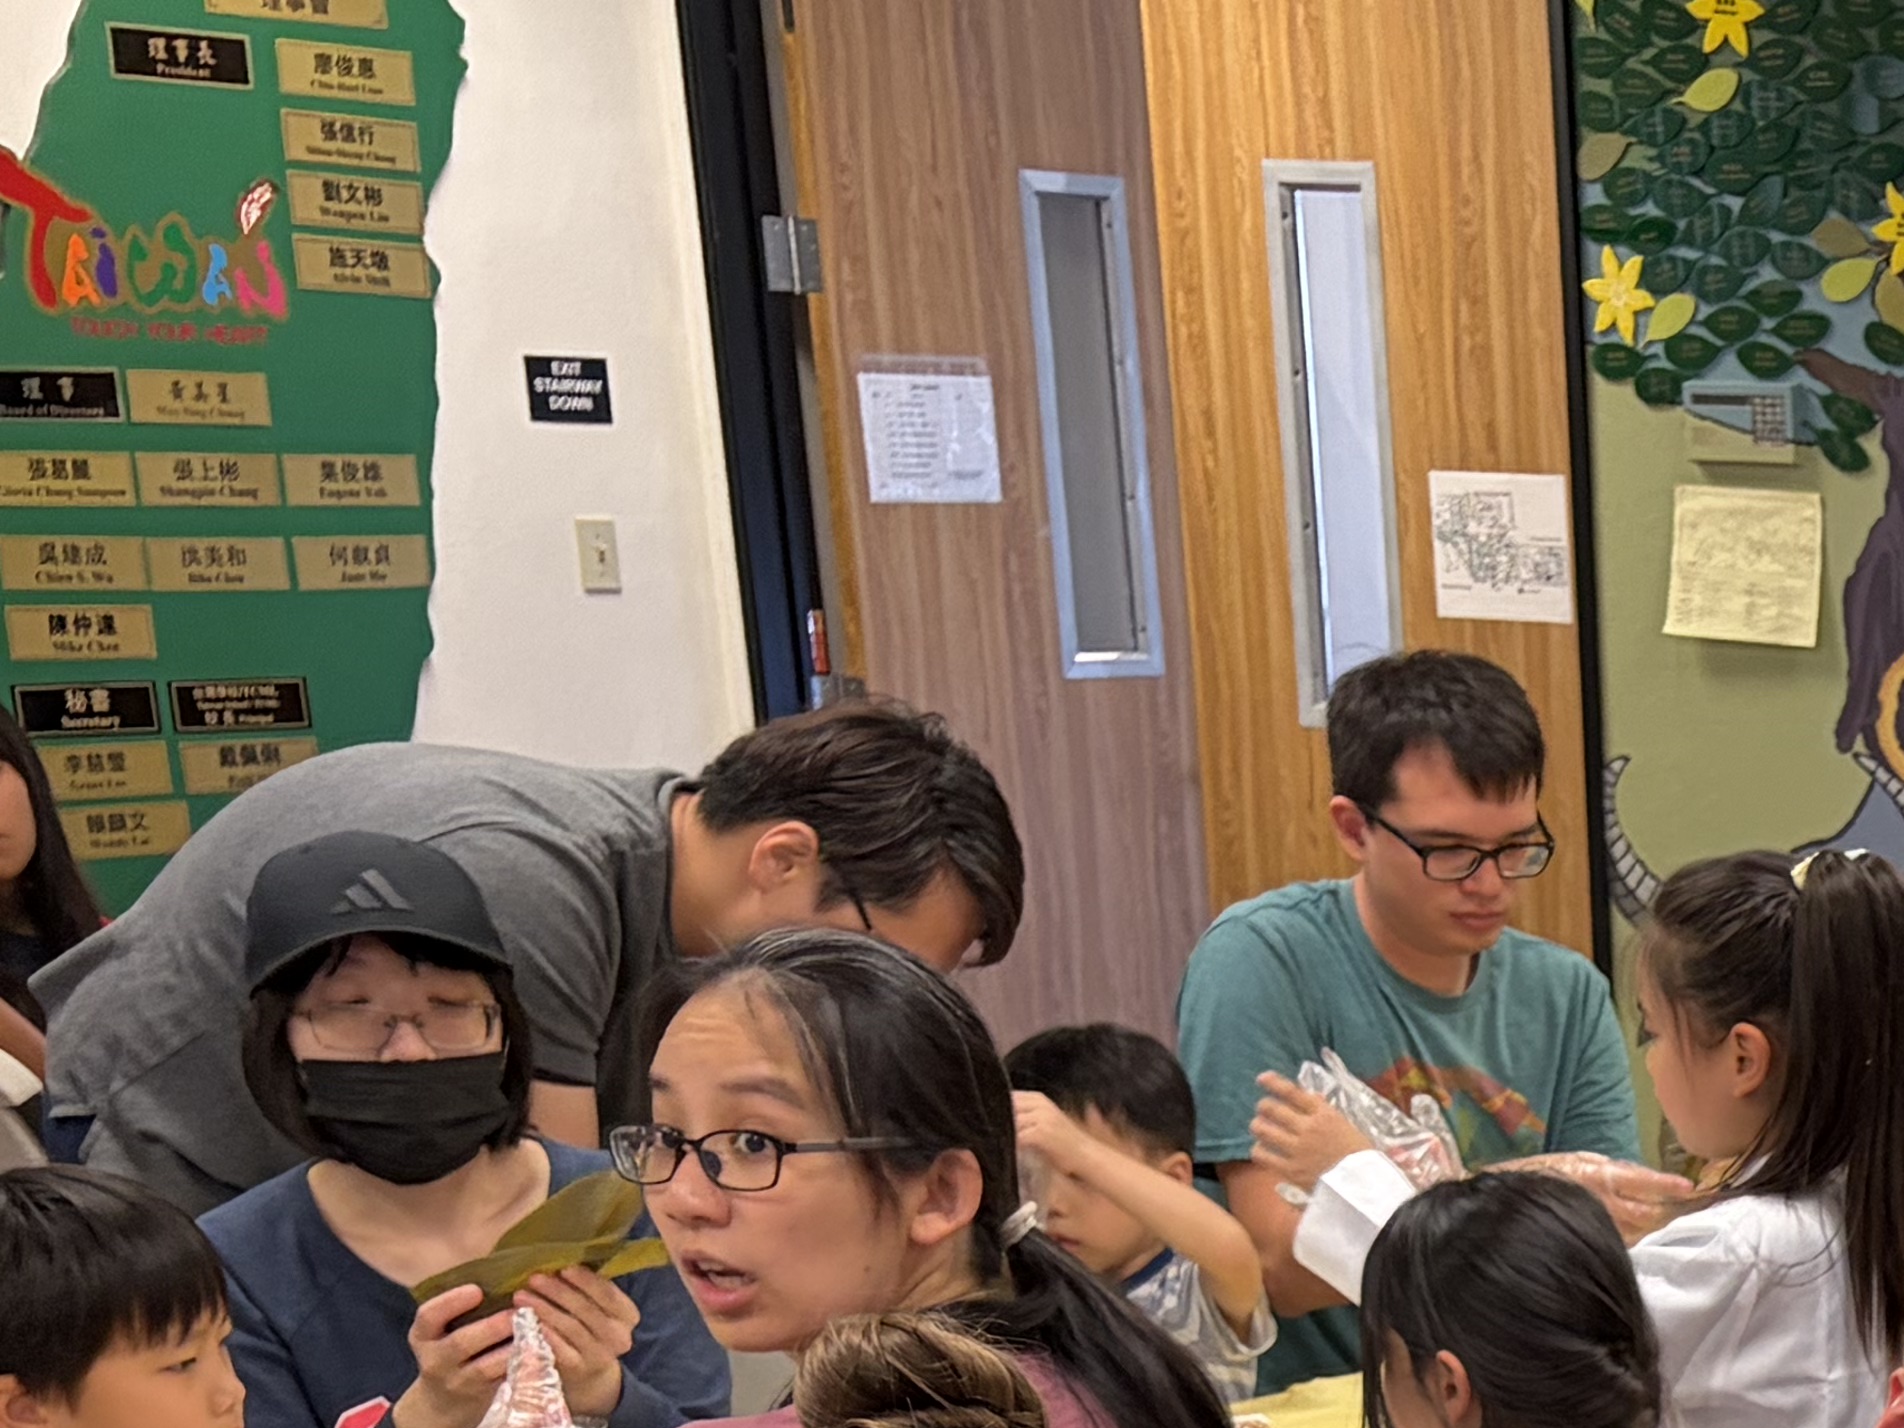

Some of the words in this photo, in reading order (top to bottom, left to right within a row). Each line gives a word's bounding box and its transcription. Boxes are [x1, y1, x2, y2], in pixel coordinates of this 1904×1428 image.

[156, 63, 212, 79] President
[550, 360, 582, 377] EXIT
[532, 376, 603, 396] STAIRWAY
[548, 394, 595, 413] DOWN
[64, 687, 112, 714] 秘書
[60, 714, 121, 730] Secretary
